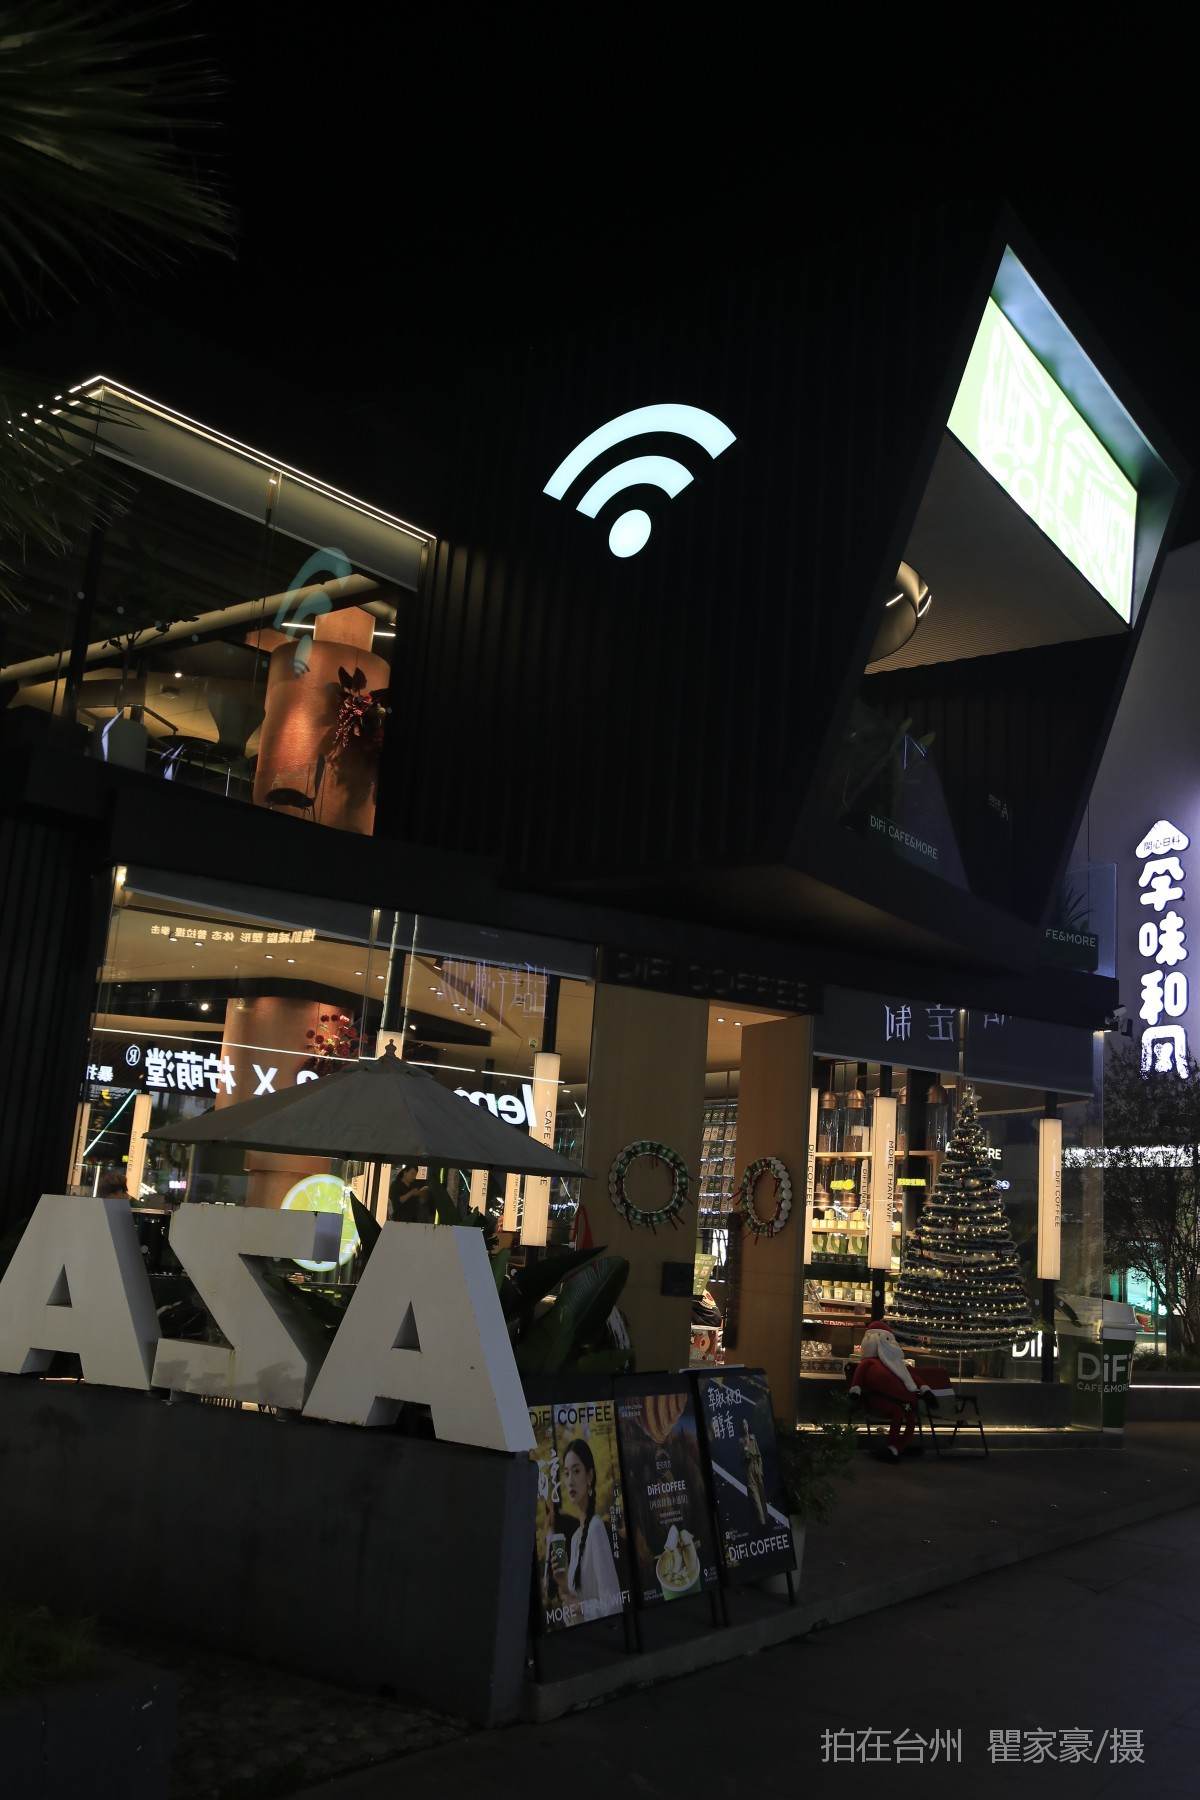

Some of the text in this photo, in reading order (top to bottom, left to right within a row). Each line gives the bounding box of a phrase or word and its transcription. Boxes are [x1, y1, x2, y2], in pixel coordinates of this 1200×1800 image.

[543, 1110, 553, 1139] CAFE
[886, 1172, 894, 1200] THAN
[1077, 1351, 1132, 1383] DiF
[529, 1410, 554, 1429] DiF
[557, 1404, 613, 1426] COFFEE
[661, 1479, 687, 1494] COFFEE
[750, 1534, 790, 1556] COFFEE
[546, 1605, 577, 1625] MORE
